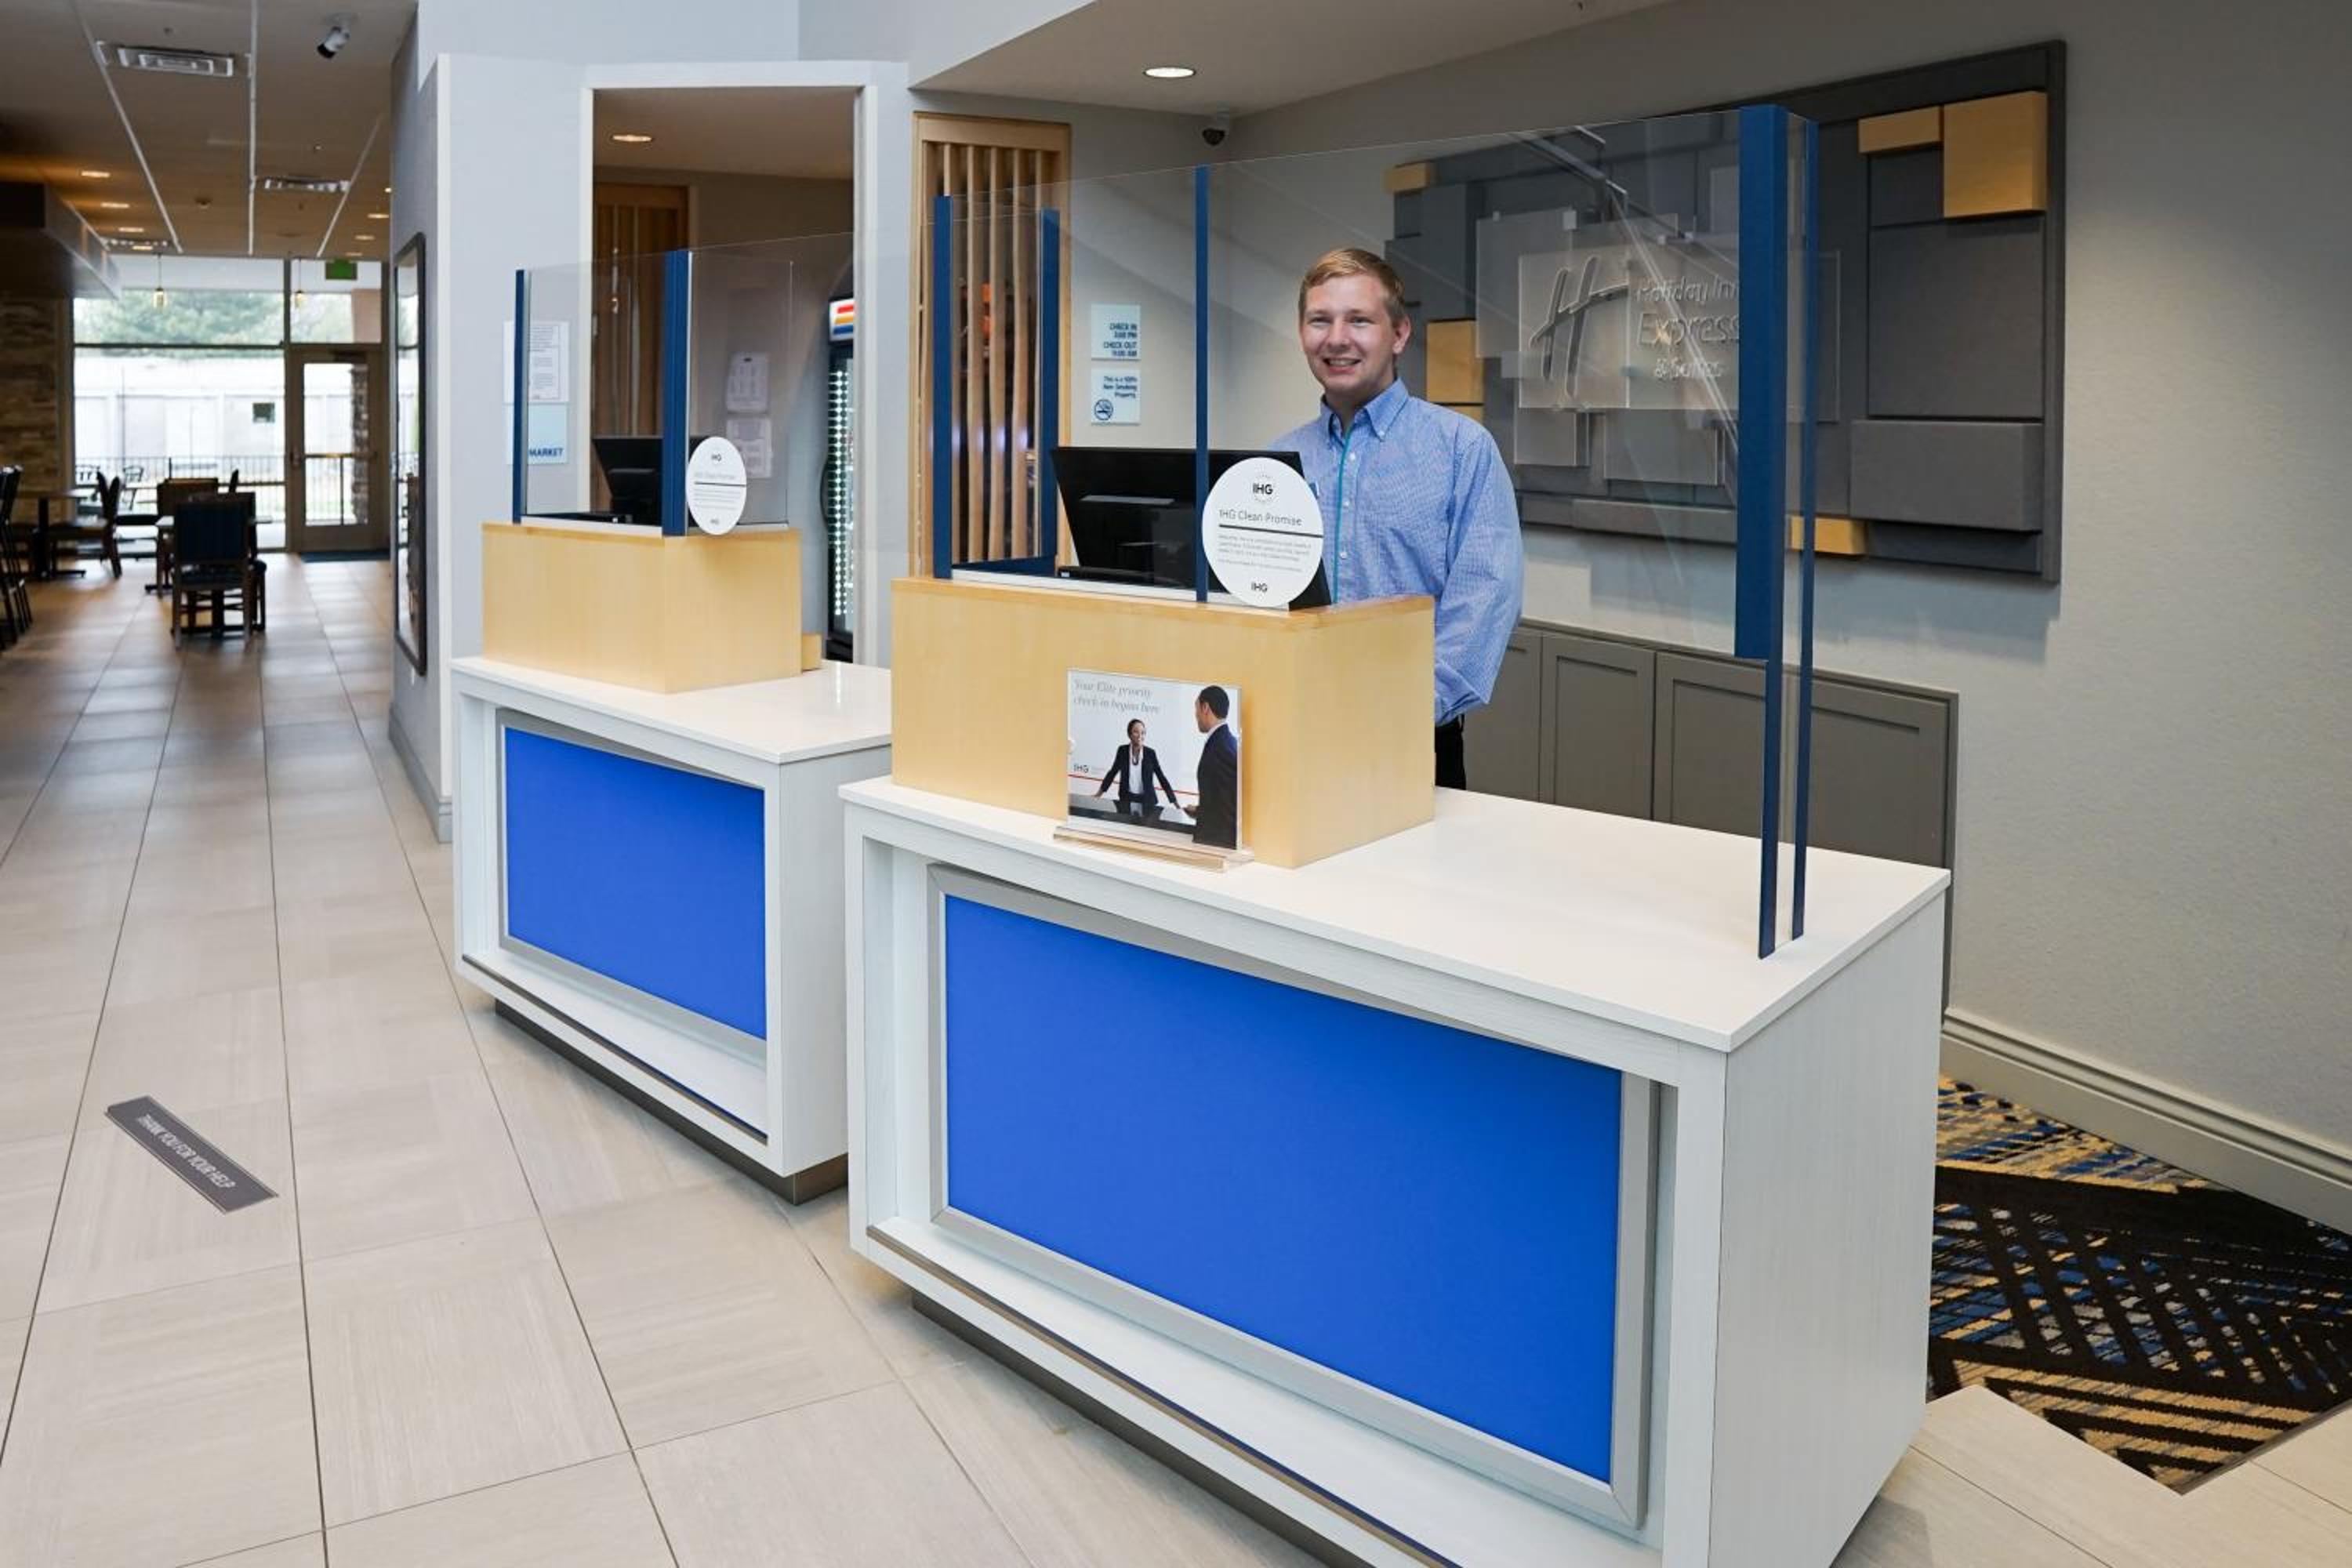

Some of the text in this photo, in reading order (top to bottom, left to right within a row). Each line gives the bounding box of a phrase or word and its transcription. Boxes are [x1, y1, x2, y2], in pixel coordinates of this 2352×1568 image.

[528, 448, 564, 457] MARKET
[1252, 483, 1273, 495] IHG
[1219, 509, 1303, 526] IHG Clean Promise
[1250, 582, 1268, 592] IHG
